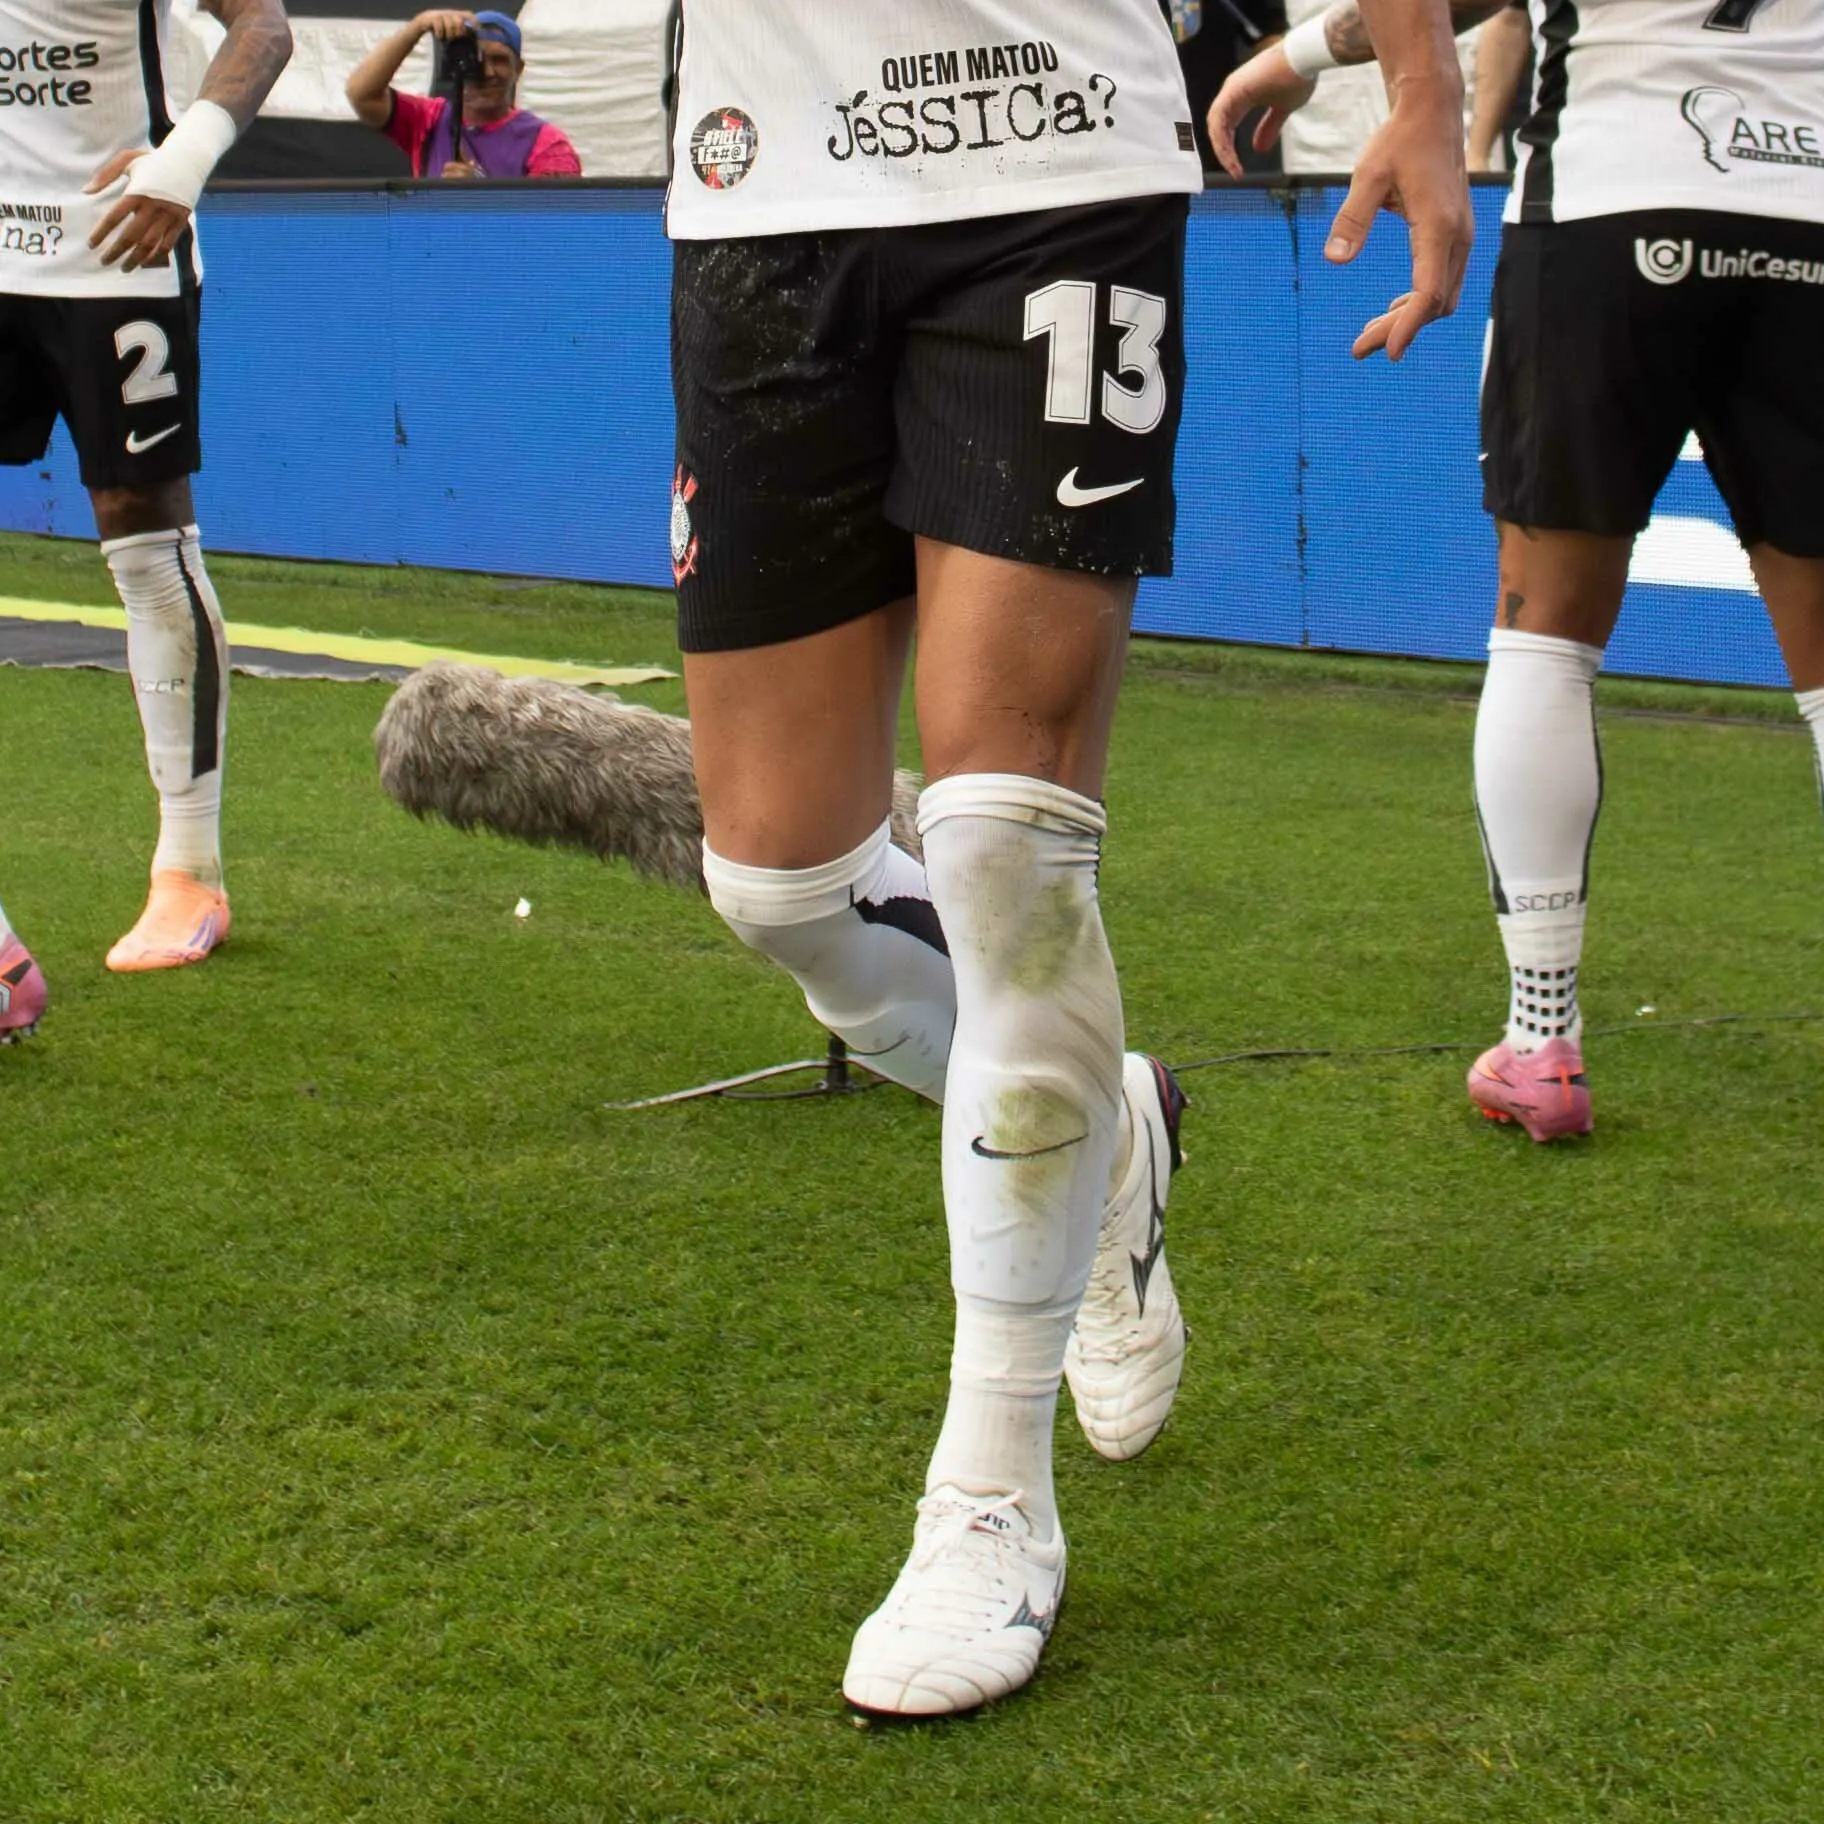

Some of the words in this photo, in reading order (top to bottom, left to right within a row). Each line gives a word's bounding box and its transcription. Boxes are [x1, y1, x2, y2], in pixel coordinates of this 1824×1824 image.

[881, 50, 960, 93] QUEM
[965, 40, 1059, 82] MATOU
[16, 203, 62, 223] MATOU
[113, 320, 179, 405] 2
[1023, 279, 1166, 434] 13
[1515, 891, 1575, 912] SCCP
